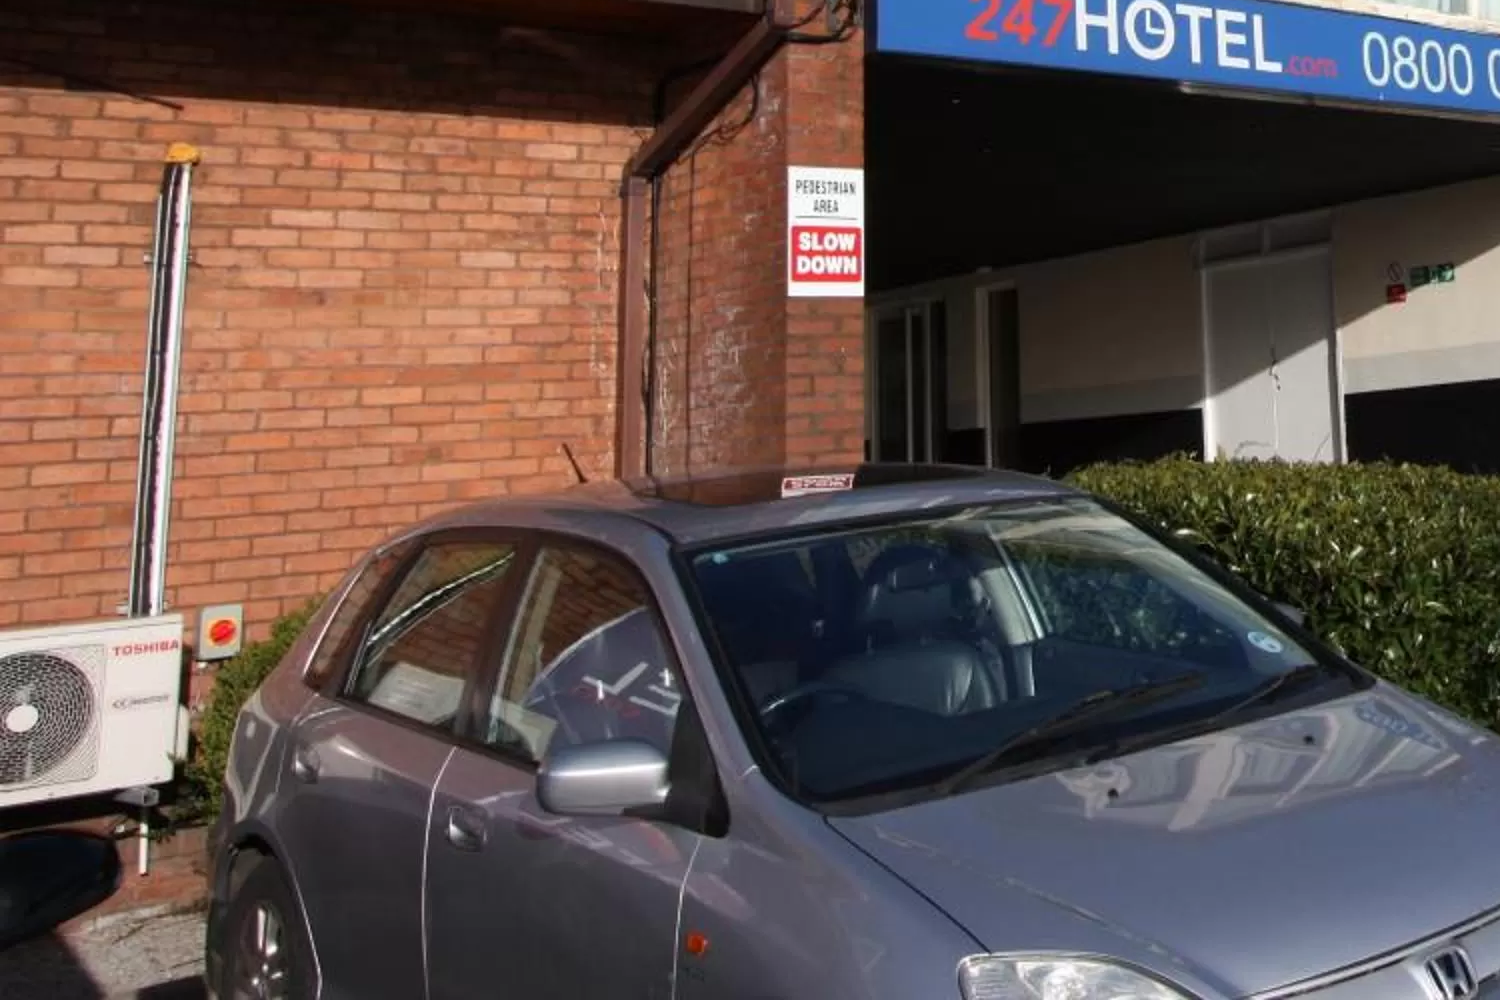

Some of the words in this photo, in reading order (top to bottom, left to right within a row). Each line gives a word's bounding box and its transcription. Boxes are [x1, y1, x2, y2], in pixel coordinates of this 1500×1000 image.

[1363, 31, 1473, 96] 0800
[795, 179, 856, 195] PEDESTRIAN
[813, 199, 839, 213] AREA
[799, 231, 856, 251] SLOW
[797, 256, 857, 274] DOWN
[112, 639, 179, 656] TOSHIBA
